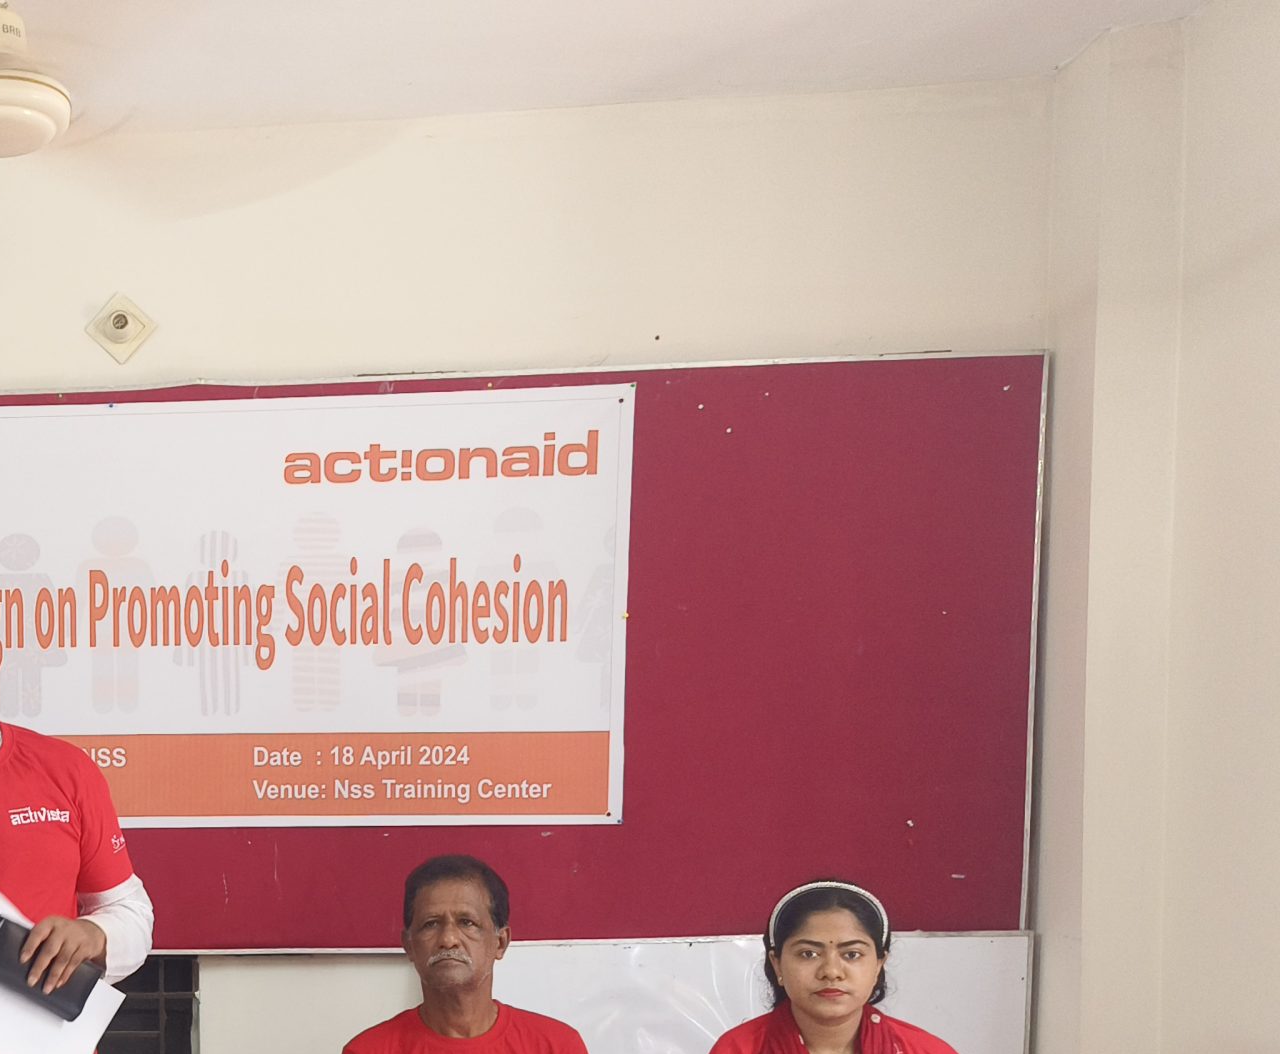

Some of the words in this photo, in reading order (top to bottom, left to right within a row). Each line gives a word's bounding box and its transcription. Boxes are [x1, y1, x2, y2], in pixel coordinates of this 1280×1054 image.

[34, 587, 78, 649] on
[89, 558, 275, 671] Promoting
[285, 556, 393, 647] Social
[402, 553, 568, 646] Cohesion
[252, 746, 302, 766] Date
[330, 746, 355, 766] 18
[360, 745, 412, 770] April
[419, 746, 470, 766] 2024
[252, 779, 326, 799] Venue:
[334, 779, 375, 799] Nss
[382, 777, 471, 804] Training
[477, 777, 552, 799] Center
[8, 806, 70, 826] activista
